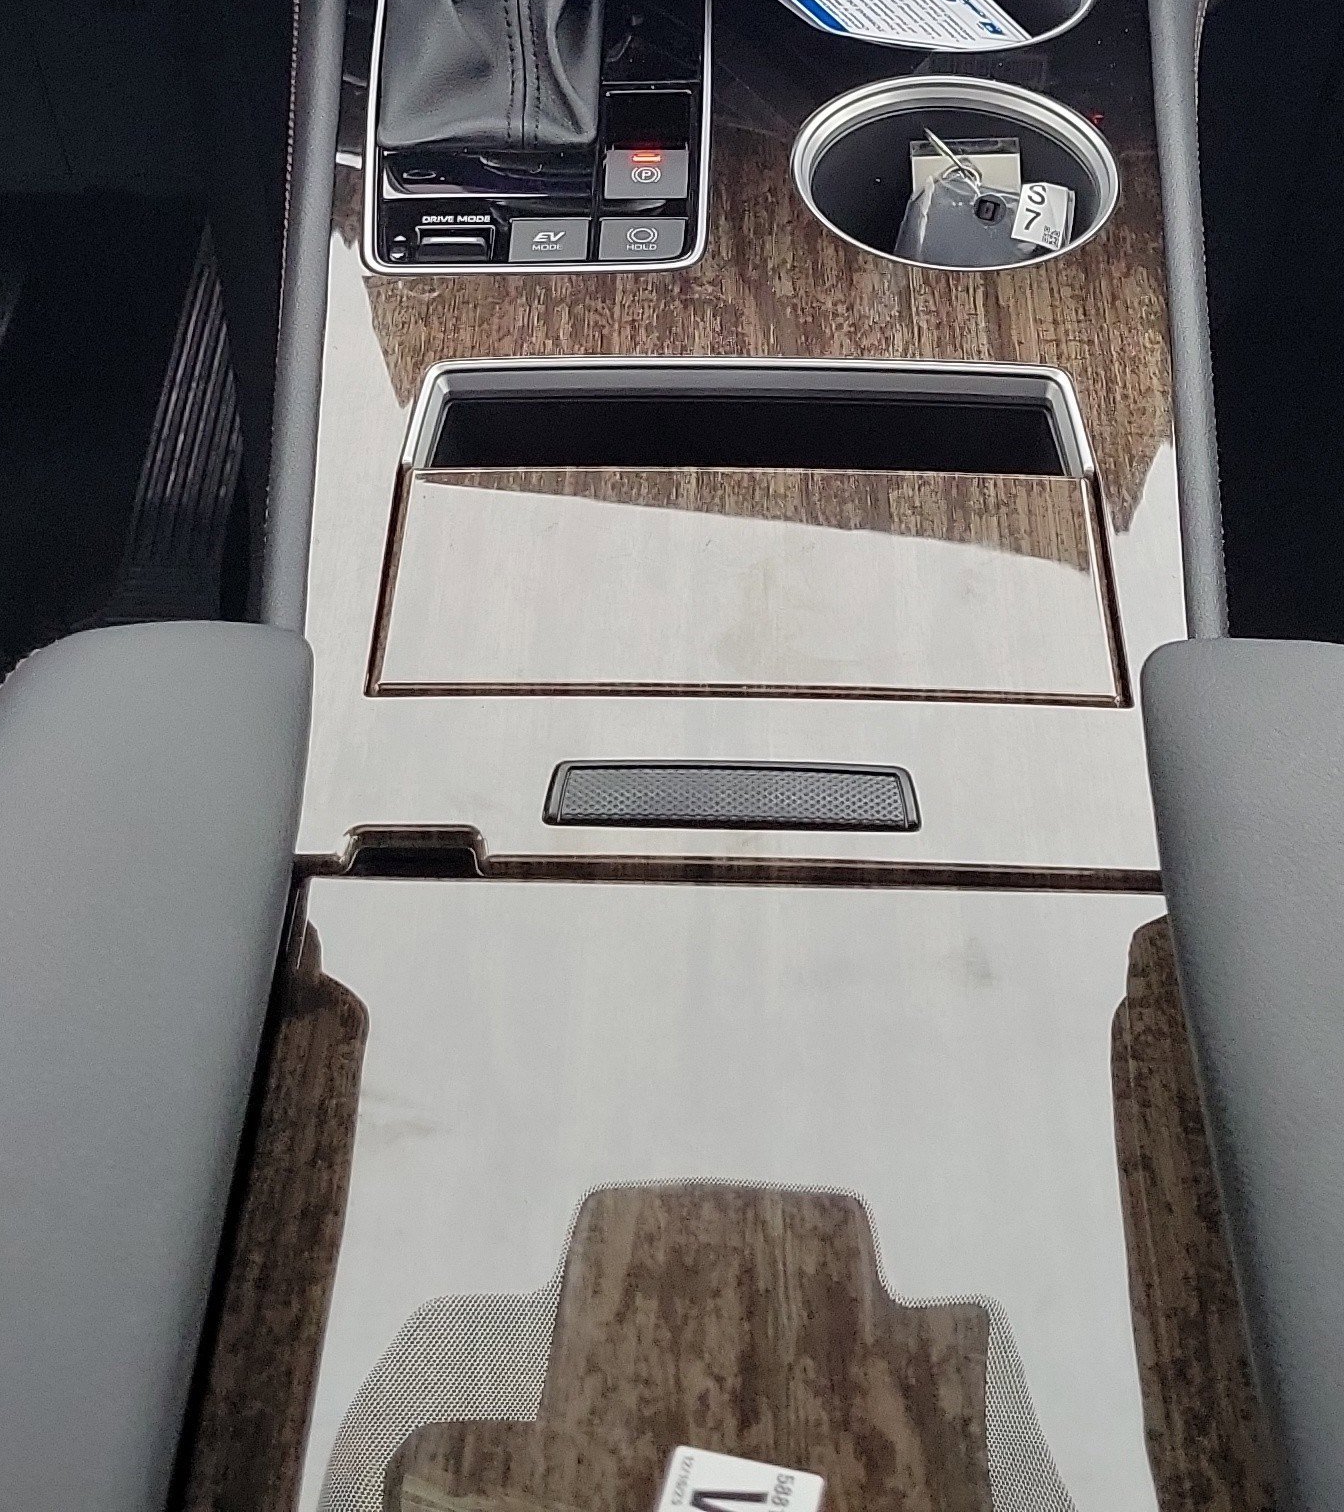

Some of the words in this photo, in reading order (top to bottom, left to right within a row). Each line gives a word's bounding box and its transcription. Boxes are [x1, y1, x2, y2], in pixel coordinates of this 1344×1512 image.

[1026, 184, 1047, 206] S
[421, 214, 455, 224] DRIVE
[456, 214, 492, 224] MODE
[1023, 207, 1042, 231] 7
[532, 231, 566, 242] EV
[531, 243, 563, 252] MODE
[626, 243, 658, 252] HOLD
